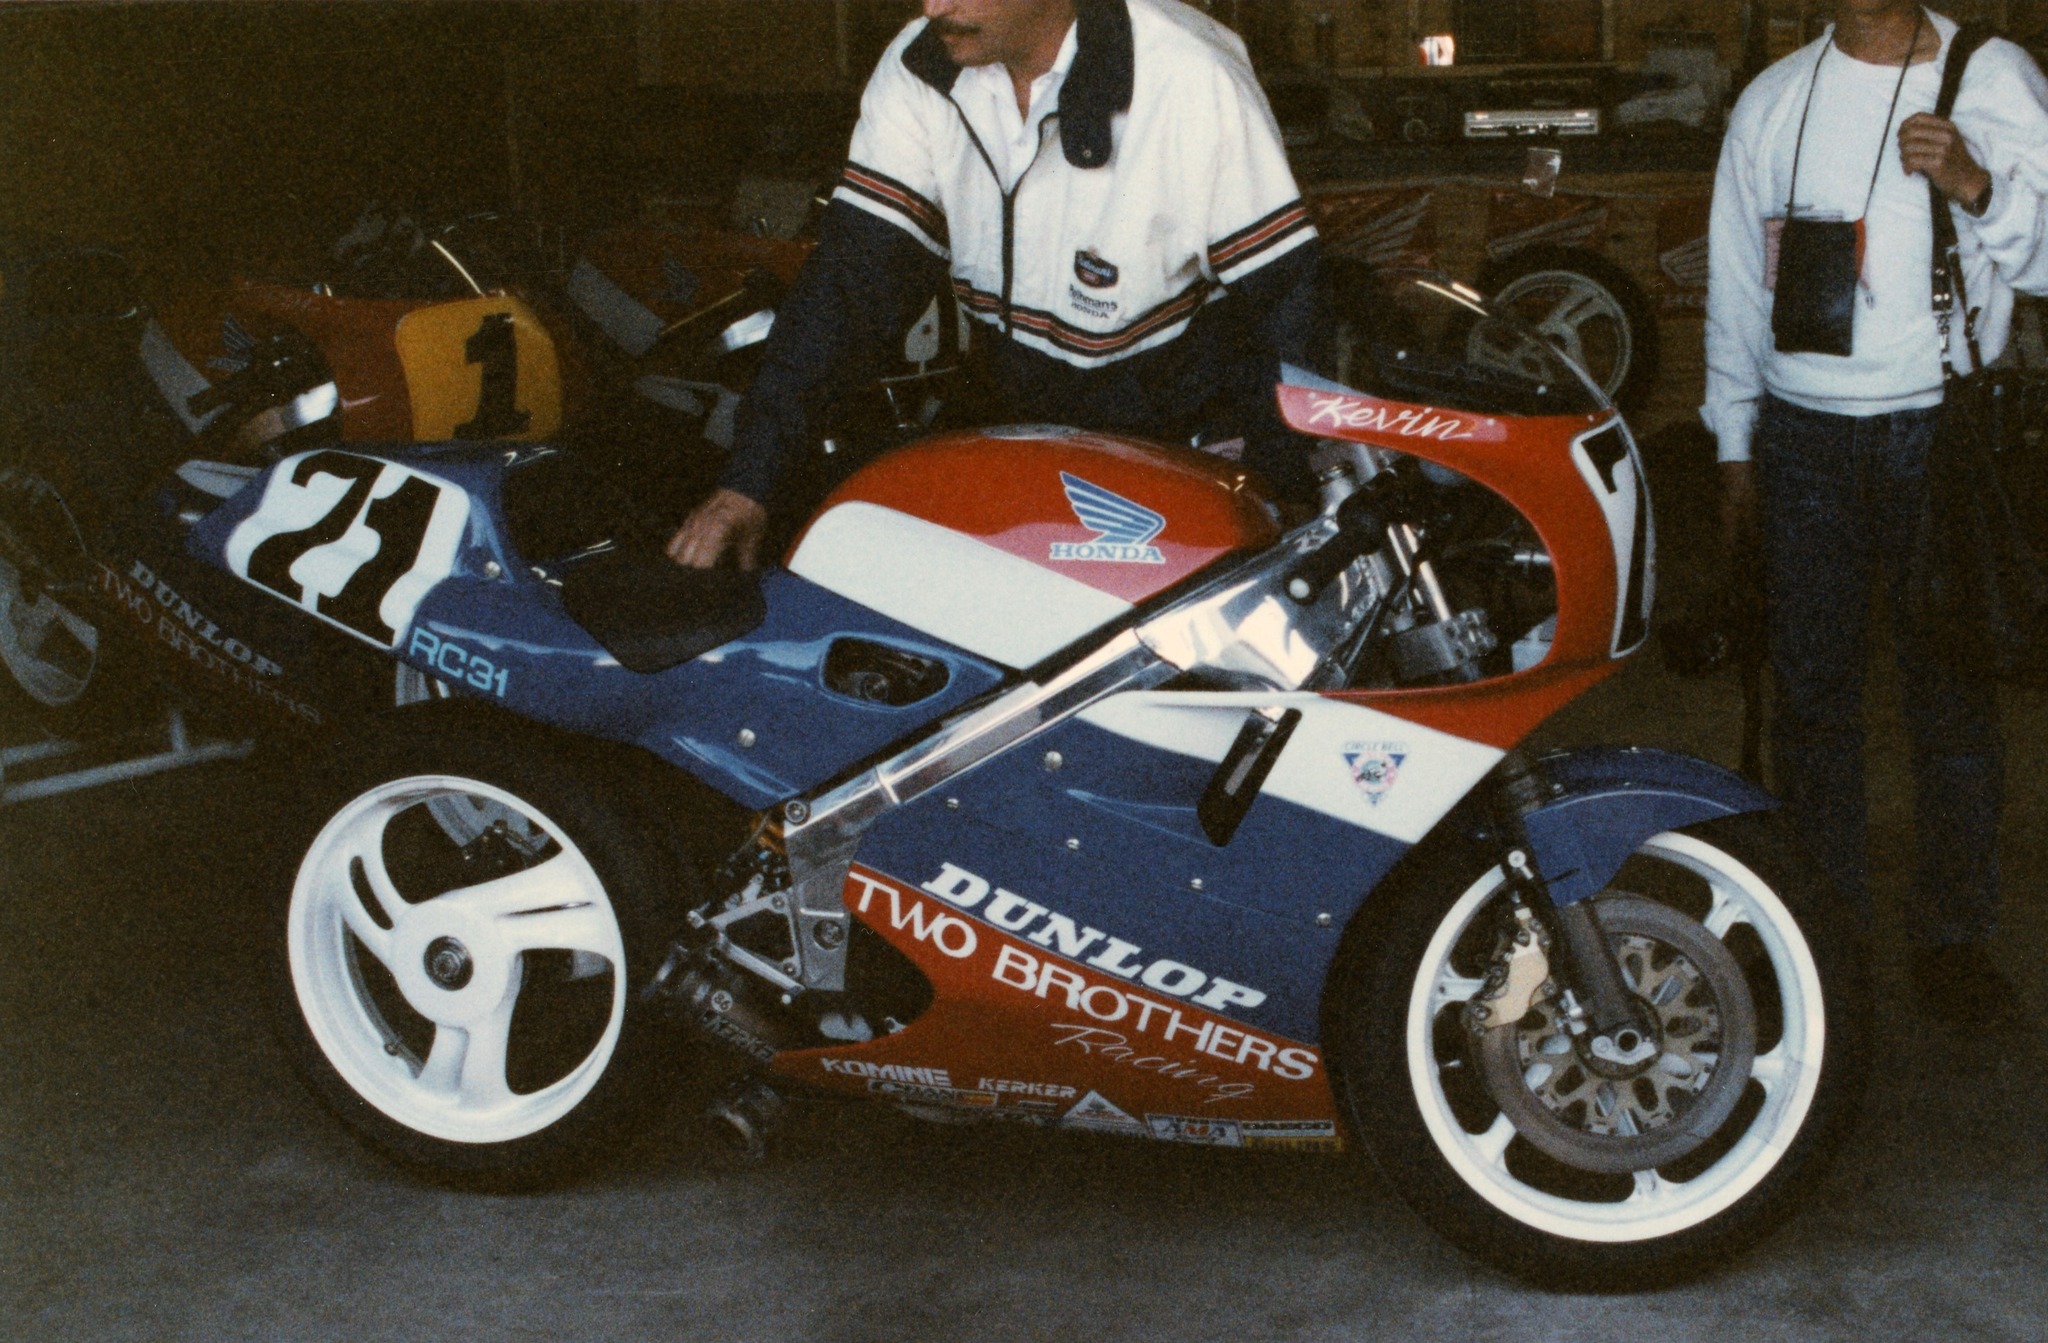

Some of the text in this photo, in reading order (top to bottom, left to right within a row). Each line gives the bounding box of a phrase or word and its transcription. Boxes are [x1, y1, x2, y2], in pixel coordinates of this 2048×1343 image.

[453, 313, 531, 437] 1
[1308, 396, 1475, 441] Kevin
[1048, 542, 1166, 565] HONDA
[130, 559, 284, 677] DUNLOP
[409, 627, 510, 699] RC31
[920, 861, 1268, 1011] DUNLOP
[848, 870, 1320, 1081] TWO BROTHERS
[821, 1057, 953, 1089] KOMINE
[978, 1077, 1077, 1100] KERKER
[1050, 1022, 1256, 1104] Racing
